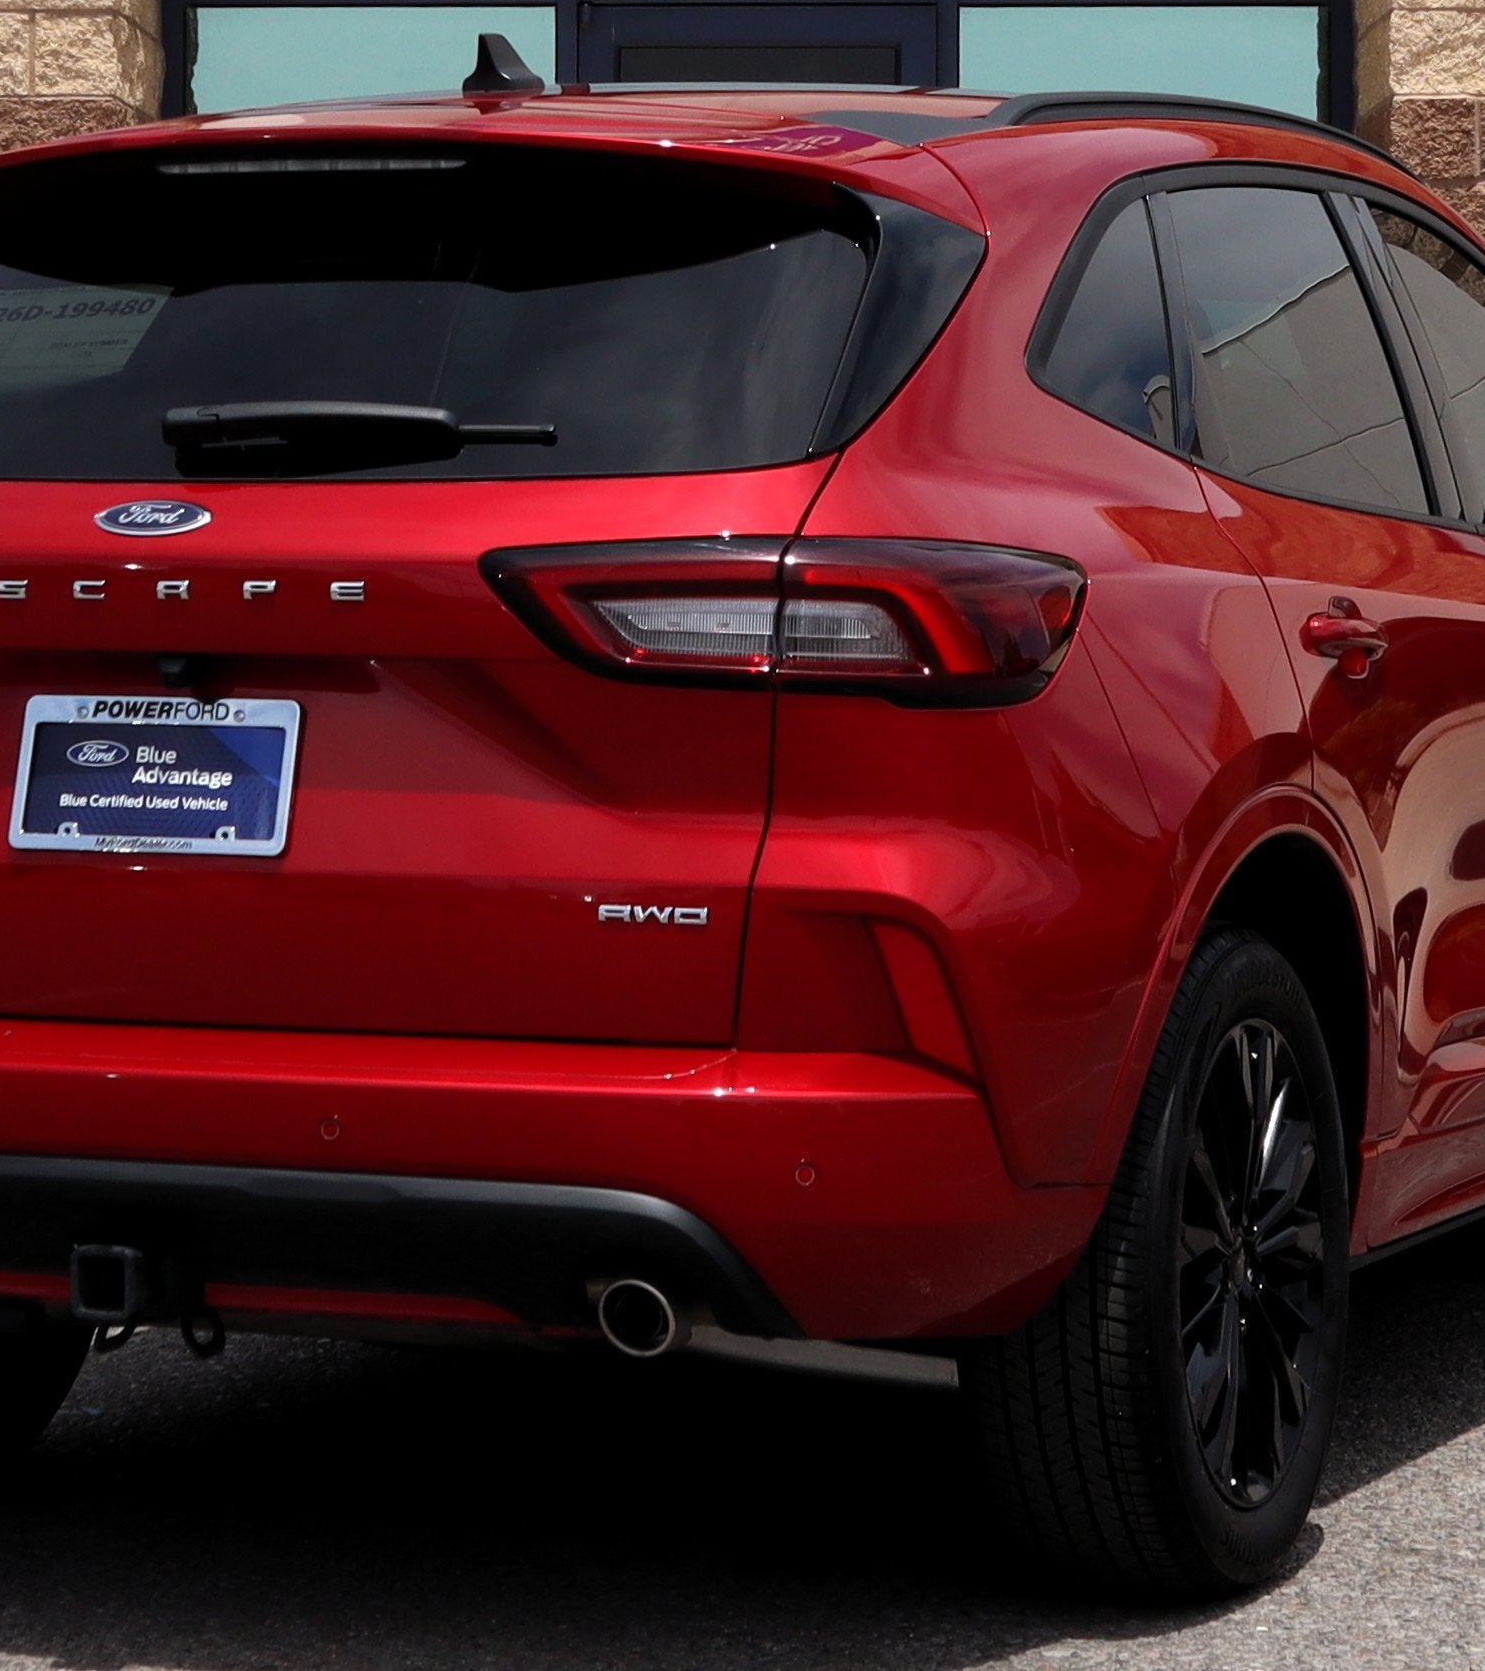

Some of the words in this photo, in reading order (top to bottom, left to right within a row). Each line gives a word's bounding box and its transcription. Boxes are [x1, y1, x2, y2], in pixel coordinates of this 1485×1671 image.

[118, 501, 187, 526] Ford
[77, 744, 118, 764] Ford
[135, 745, 177, 765] Blue
[131, 766, 233, 789] Advantage
[59, 793, 88, 808] Blue
[89, 794, 145, 810] Certified
[145, 796, 180, 811] Used
[181, 796, 229, 812] Vehicle
[597, 904, 709, 925] AWD
